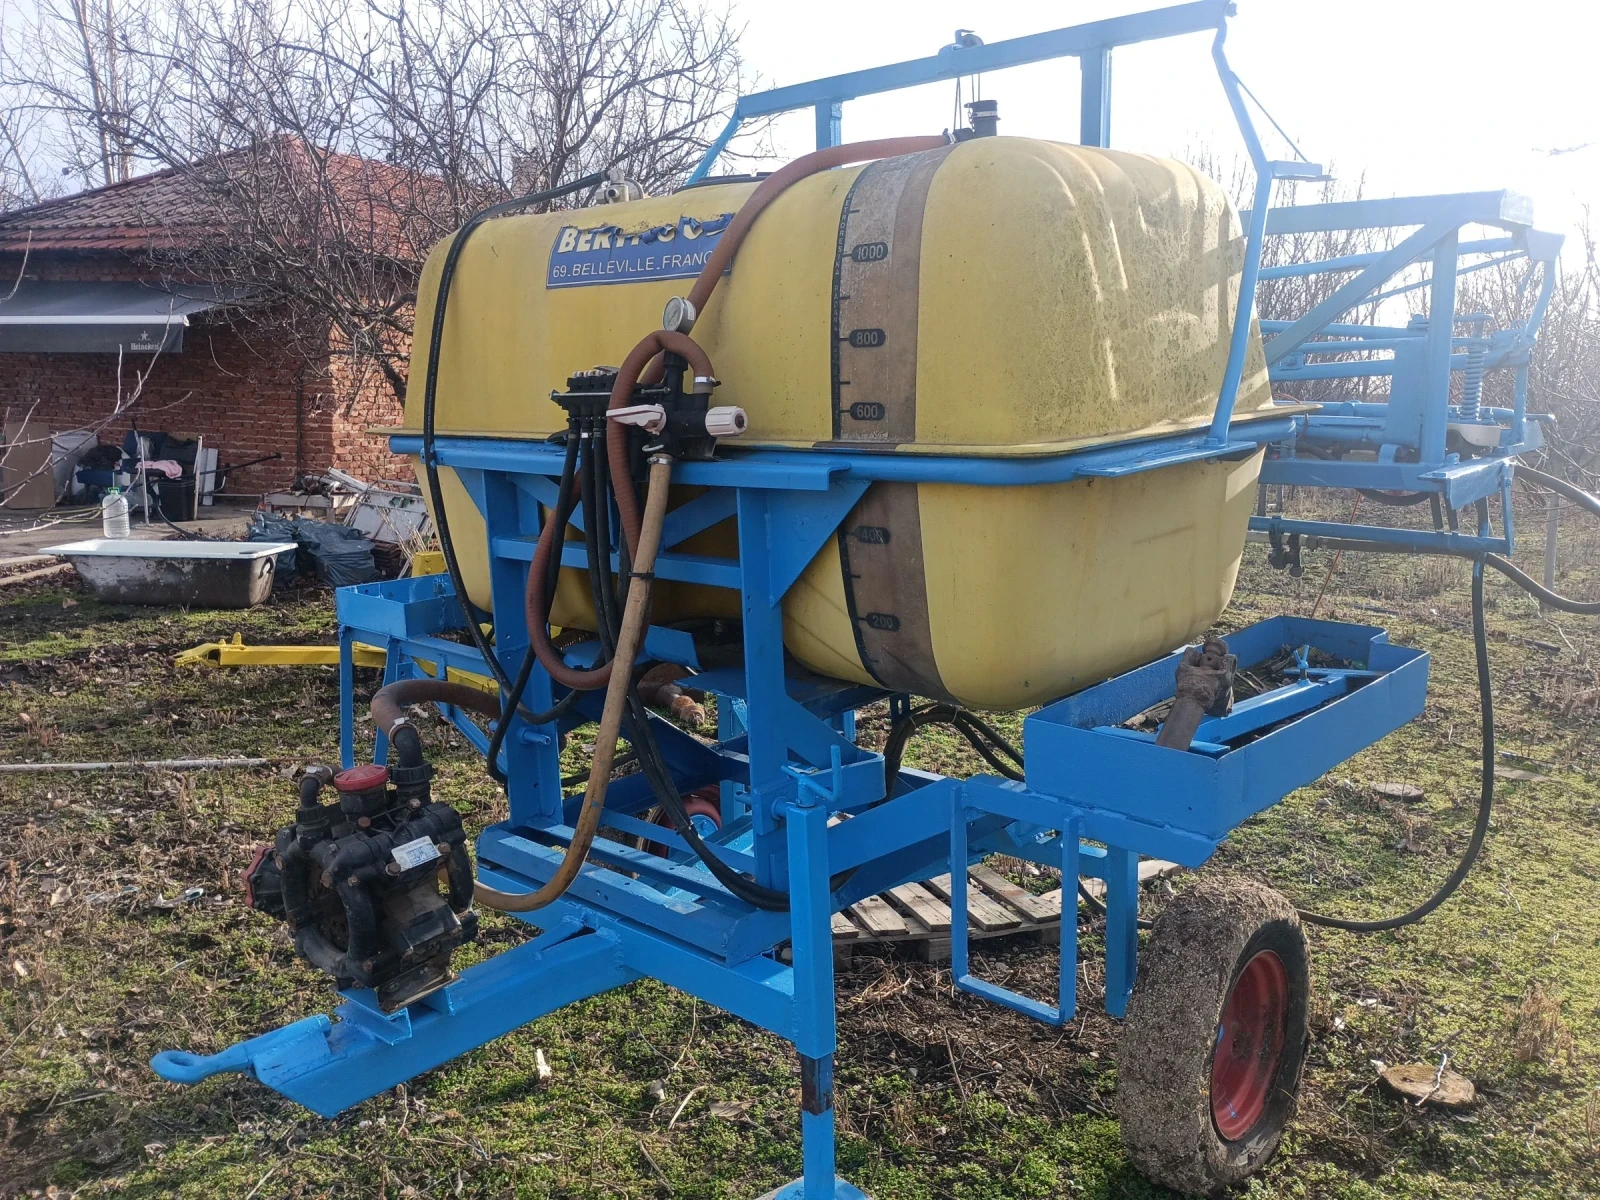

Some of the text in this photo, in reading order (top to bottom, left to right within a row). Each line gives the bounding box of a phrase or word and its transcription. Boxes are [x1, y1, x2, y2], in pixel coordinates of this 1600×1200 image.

[557, 223, 725, 253] BEROU
[857, 244, 884, 260] 1000
[856, 331, 878, 345] 800
[856, 404, 878, 419] 600
[861, 528, 884, 542] 400
[872, 615, 893, 629] 200
